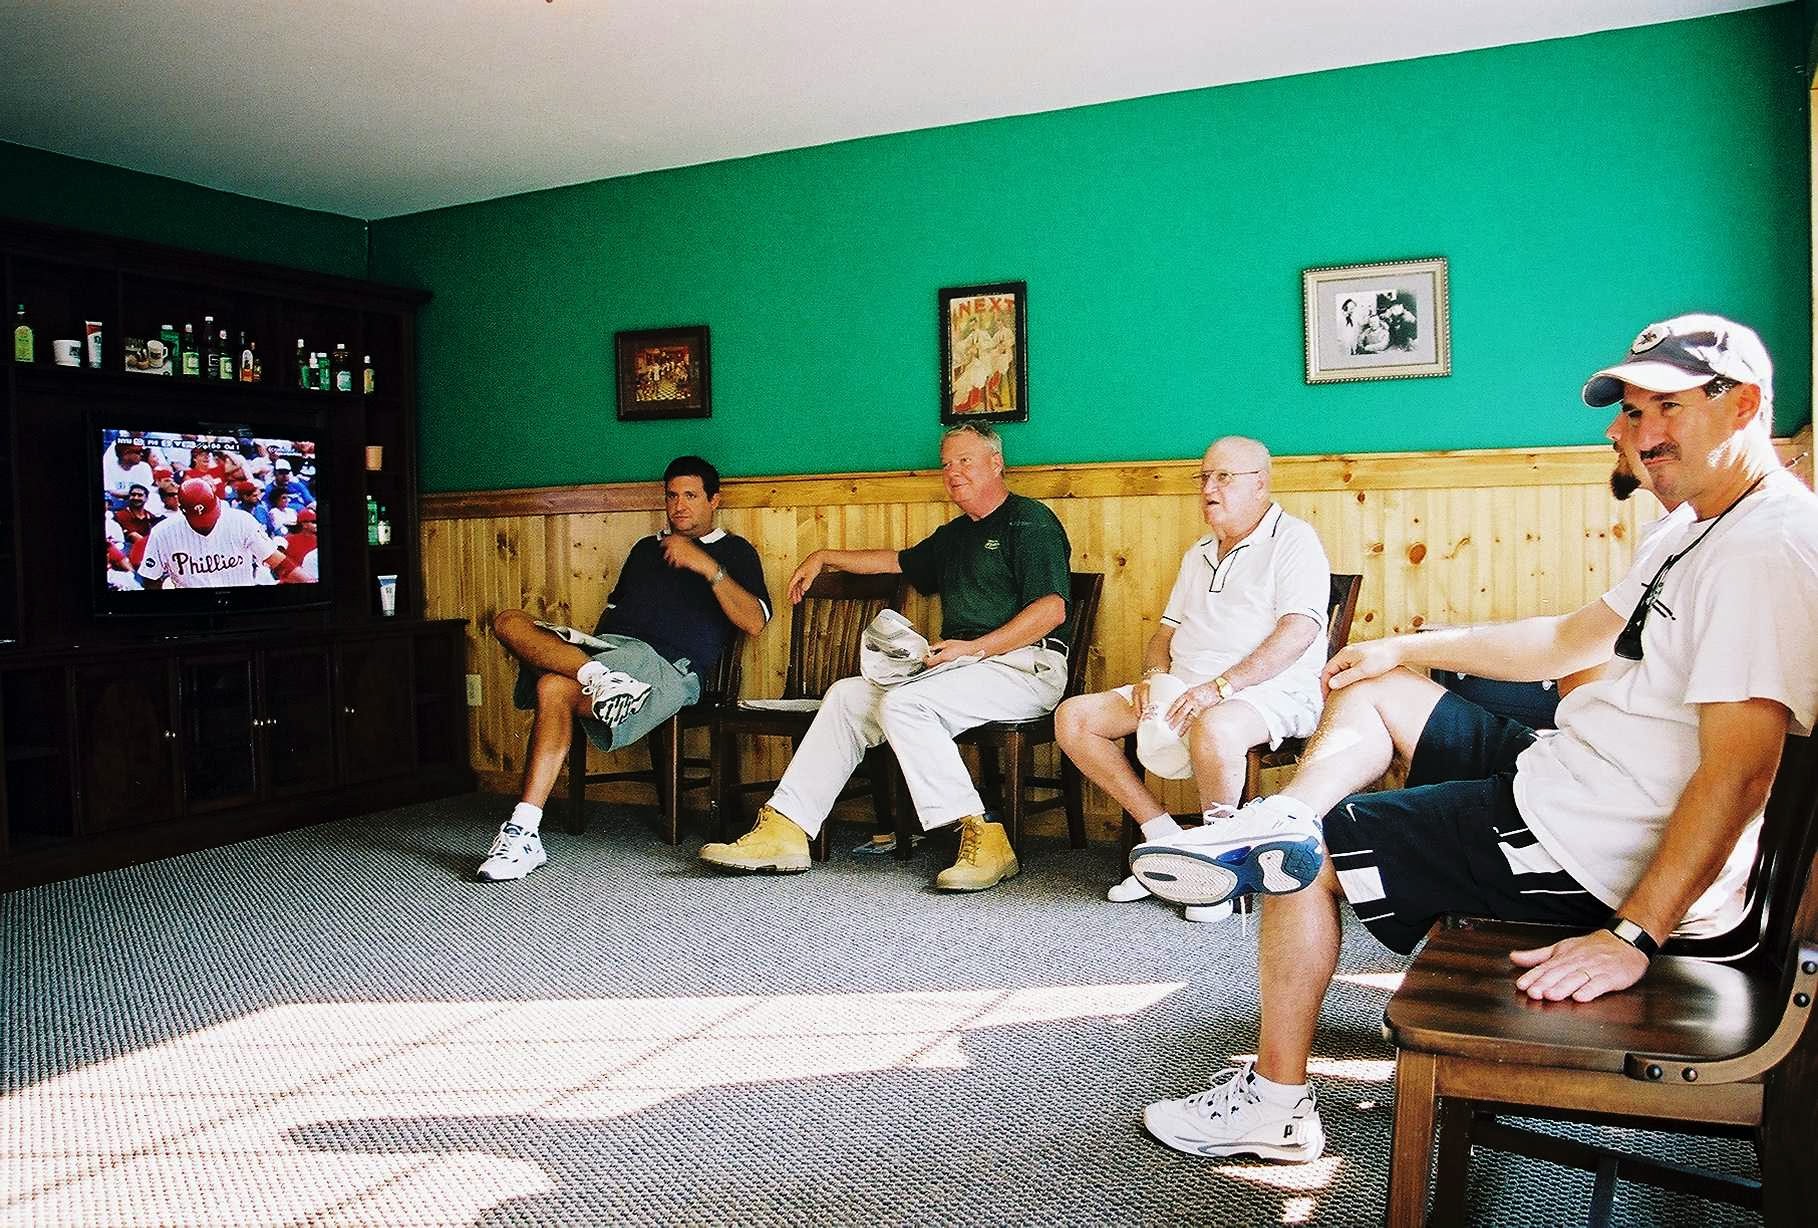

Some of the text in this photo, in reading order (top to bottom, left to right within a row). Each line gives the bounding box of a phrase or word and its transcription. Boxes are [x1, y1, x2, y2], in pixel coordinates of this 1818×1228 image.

[959, 297, 1015, 317] NEXT
[194, 504, 204, 515] P
[172, 552, 243, 575] Phillies
